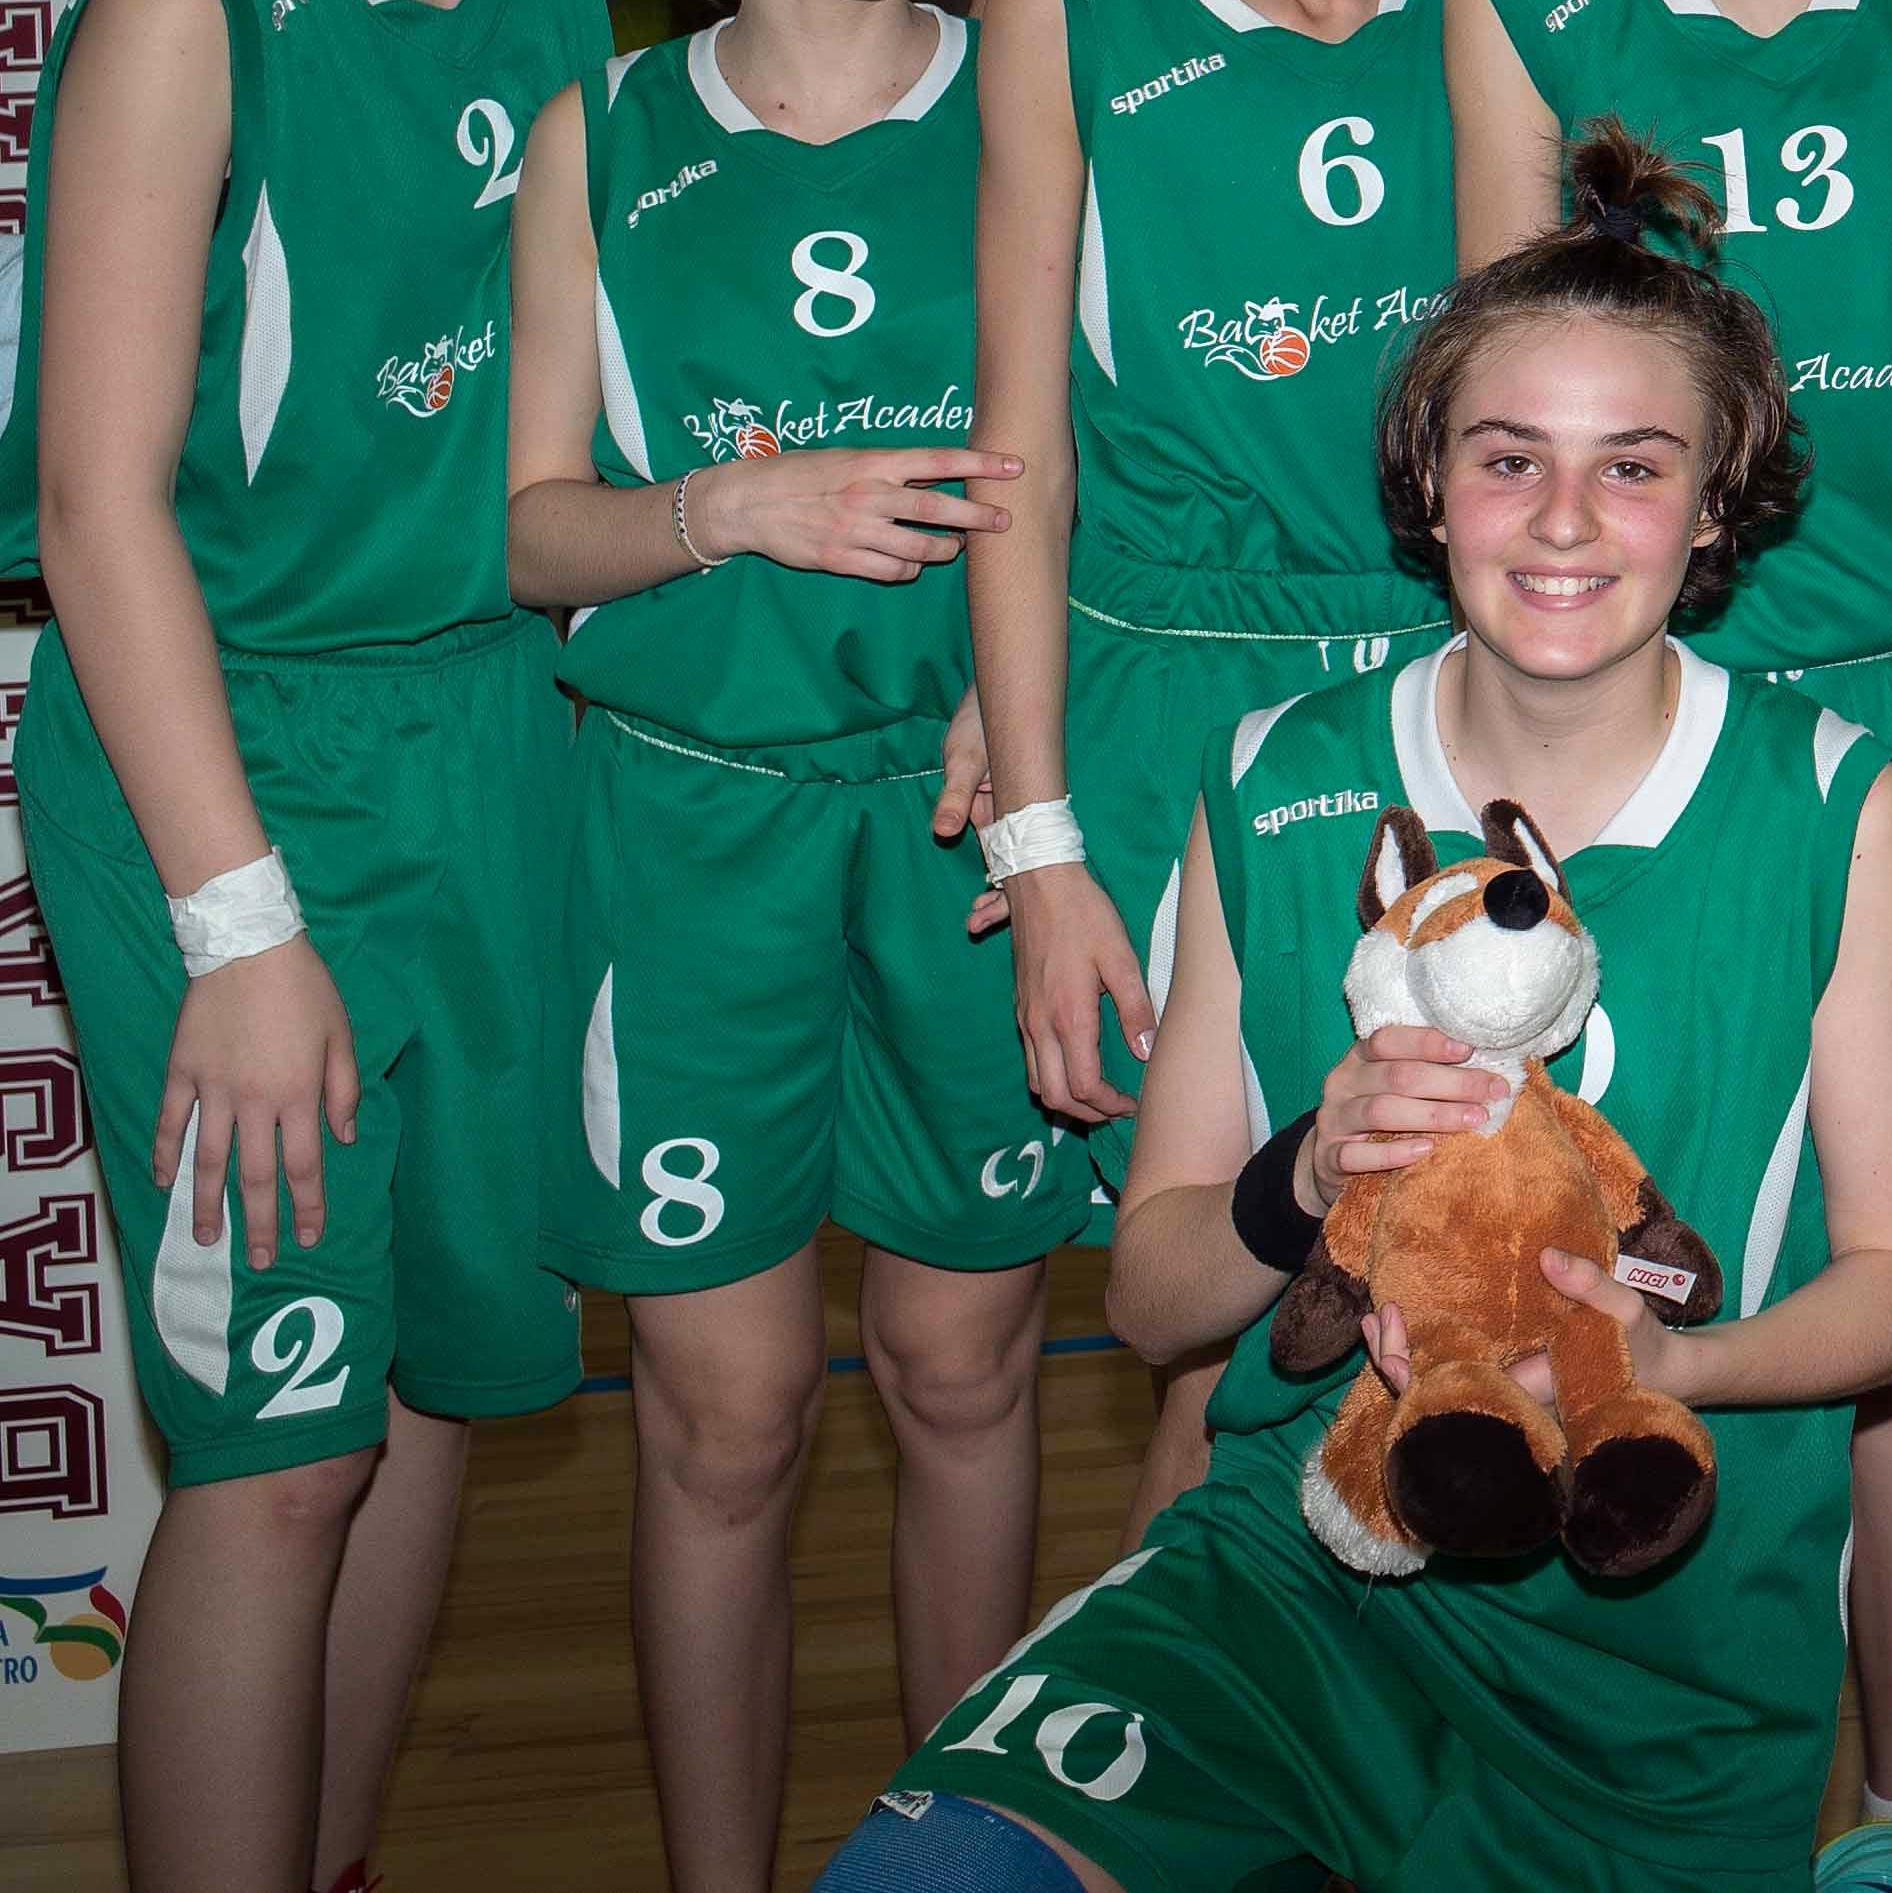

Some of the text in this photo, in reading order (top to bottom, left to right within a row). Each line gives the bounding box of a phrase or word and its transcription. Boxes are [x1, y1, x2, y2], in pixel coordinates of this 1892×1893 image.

[1111, 53, 1227, 115] sportika
[456, 98, 523, 209] 2
[1297, 116, 1385, 227] 6
[1701, 124, 1855, 235] 13
[790, 231, 877, 338] 8
[1253, 788, 1380, 838] sportika
[639, 1137, 725, 1247] 8
[1627, 1267, 1670, 1289] NICI
[250, 1297, 351, 1421] 2
[942, 1673, 1148, 1802] 10
